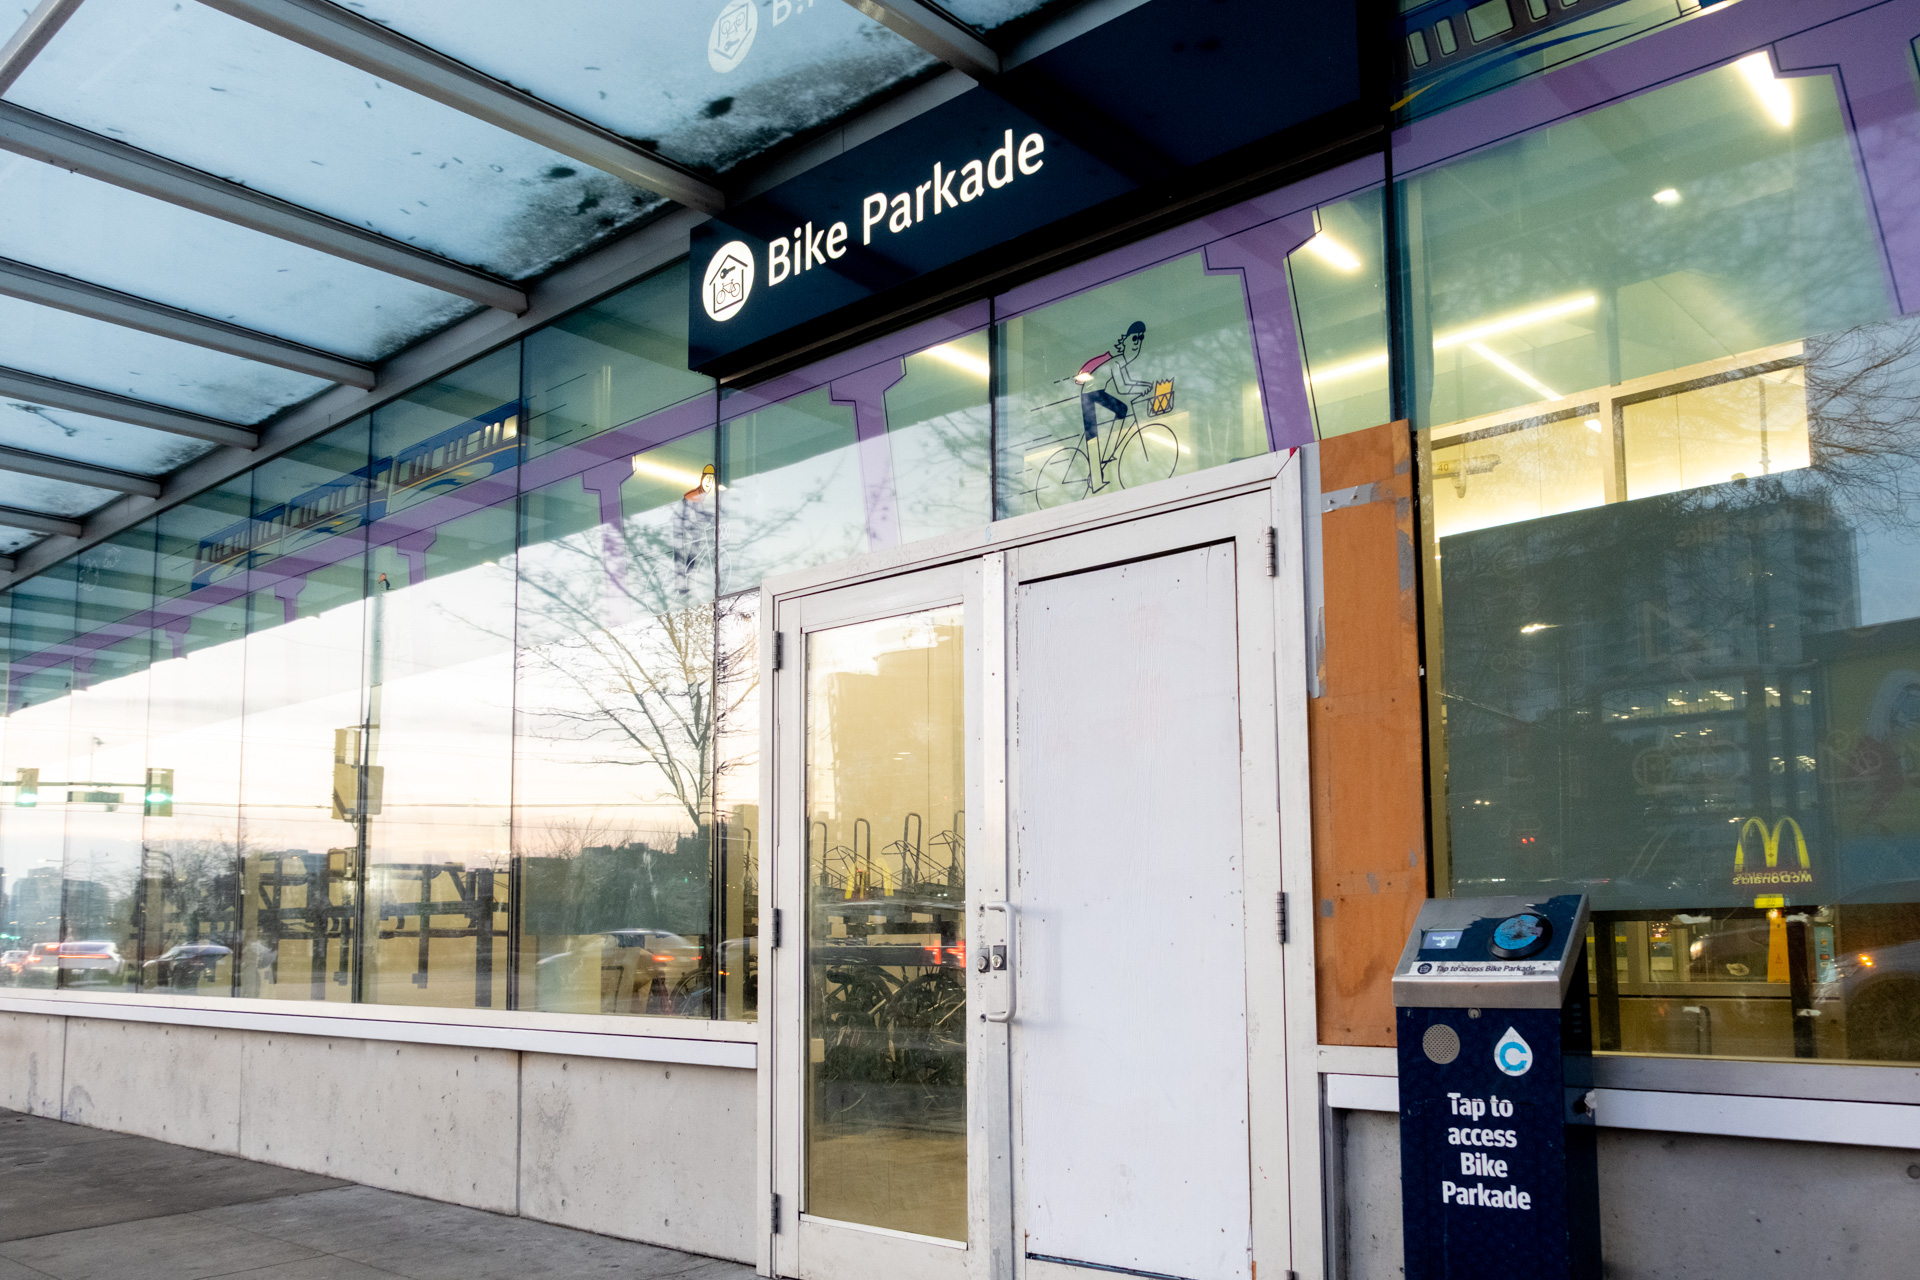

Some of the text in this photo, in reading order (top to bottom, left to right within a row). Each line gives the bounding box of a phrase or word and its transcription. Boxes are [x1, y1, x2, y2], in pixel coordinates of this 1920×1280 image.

[768, 128, 1045, 287] Bike Parkade
[1437, 463, 1449, 472] 40
[1436, 965, 1449, 973] Tap
[1446, 1092, 1514, 1121] Tap to
[1447, 1127, 1518, 1148] access
[1460, 1152, 1508, 1178] Bike
[1442, 1180, 1531, 1210] Parkade
